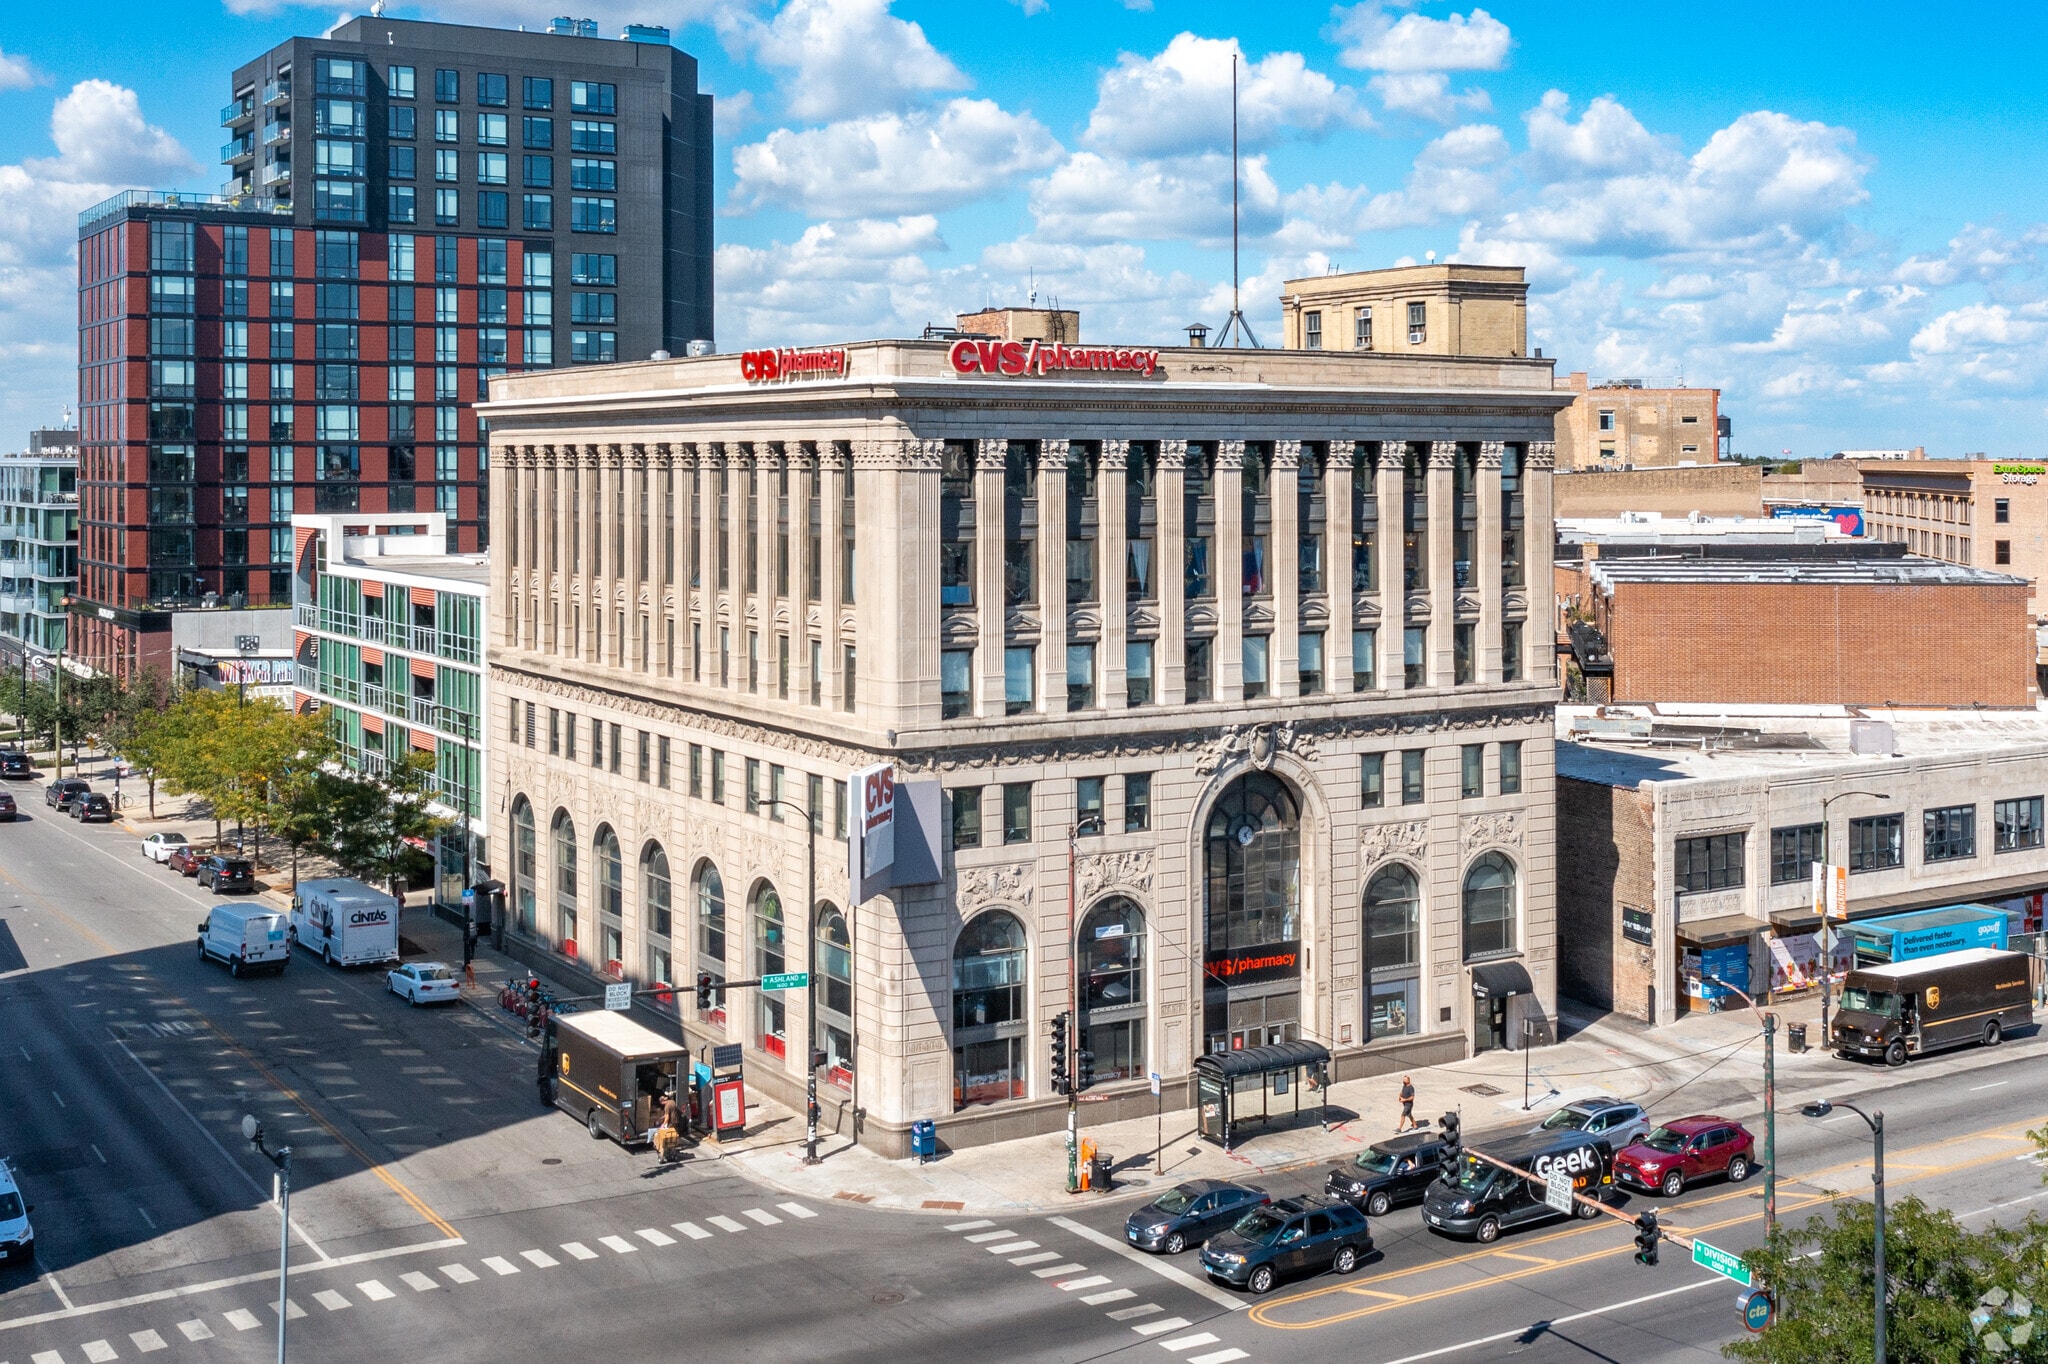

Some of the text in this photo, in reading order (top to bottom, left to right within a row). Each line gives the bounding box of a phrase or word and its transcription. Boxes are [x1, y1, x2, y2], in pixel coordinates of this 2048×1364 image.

[741, 347, 848, 380] CVS/pharmacy
[949, 339, 1159, 377] CVS/pharmacy
[2002, 473, 2038, 485] Storage
[218, 661, 293, 684] WICKER PAR
[866, 767, 894, 812] CVS
[1978, 921, 2000, 936] gopuff
[1903, 931, 1953, 945] Delivered faster
[1903, 945, 1918, 954] than
[1919, 944, 1934, 952] even
[770, 975, 800, 983] ASHLAND
[1536, 1147, 1594, 1179] Geek
[1550, 1172, 1557, 1181] DO
[1560, 1176, 1570, 1186] NOT
[1550, 1180, 1568, 1194] BLOCK
[1704, 1246, 1739, 1270] DIVISION
[1712, 1260, 1725, 1271] 1200
[1749, 1305, 1767, 1319] cta
